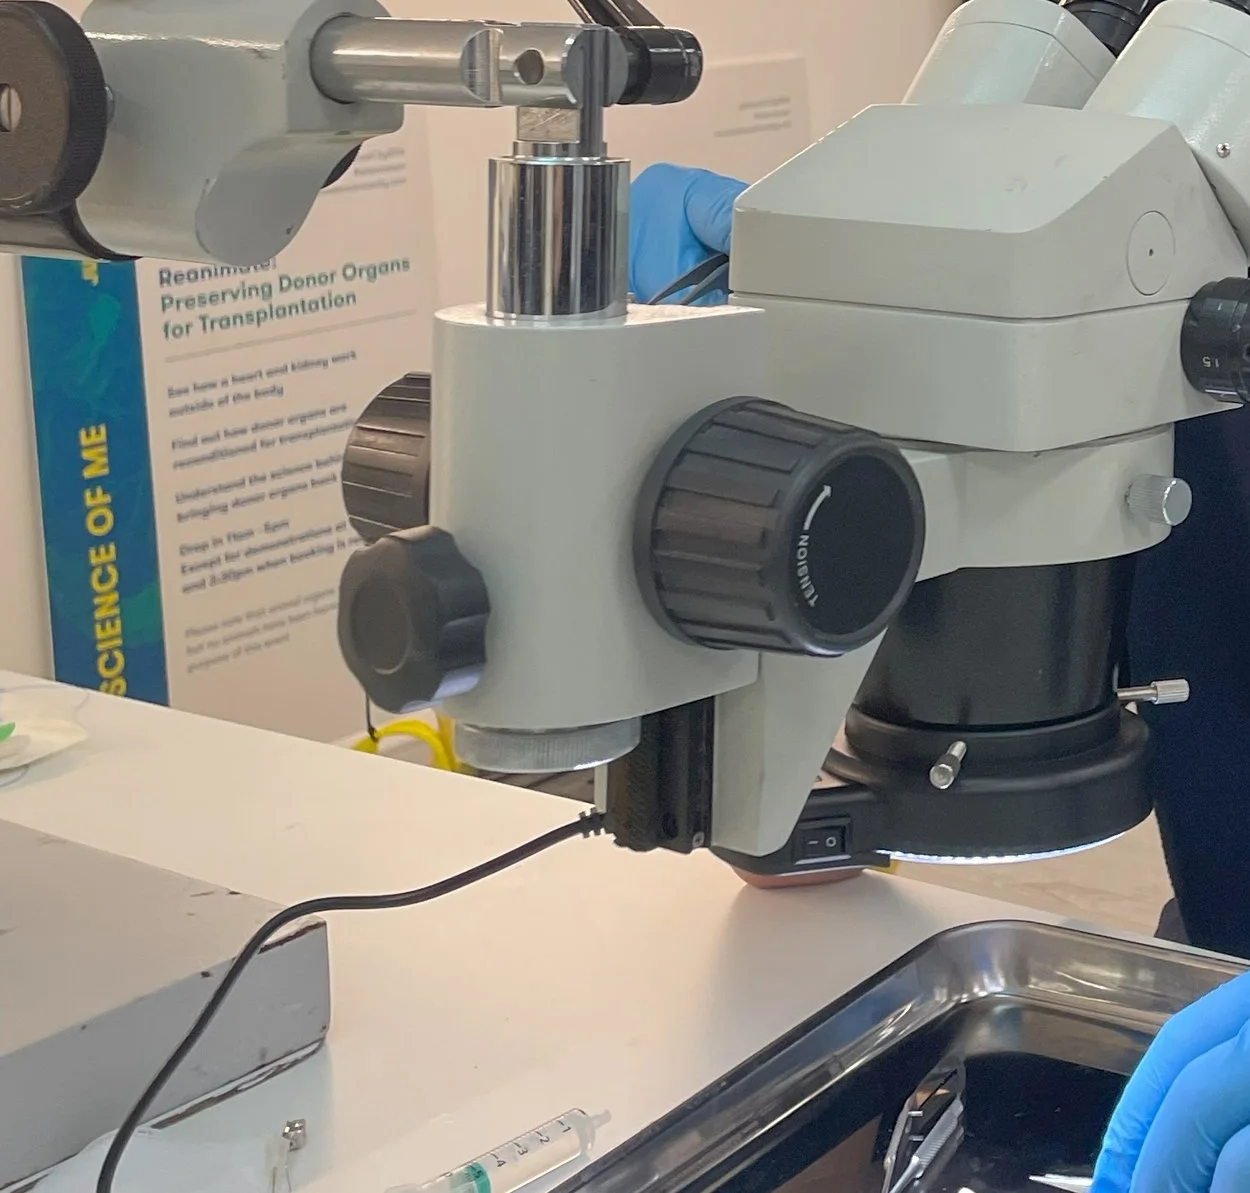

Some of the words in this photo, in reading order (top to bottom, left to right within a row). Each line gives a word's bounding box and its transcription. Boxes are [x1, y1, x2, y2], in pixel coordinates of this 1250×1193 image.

[161, 281, 272, 314] Preserving
[278, 270, 337, 294] Donor
[342, 258, 410, 283] Organs
[162, 321, 193, 341] for
[198, 291, 356, 333] Transplantation
[232, 369, 263, 384] heart
[266, 364, 288, 378] and
[291, 359, 328, 372] kidney
[254, 385, 284, 399] body
[79, 423, 109, 479] ME
[84, 486, 114, 536] OF
[796, 534, 819, 607] TENSION
[89, 541, 127, 697] SCIENCE
